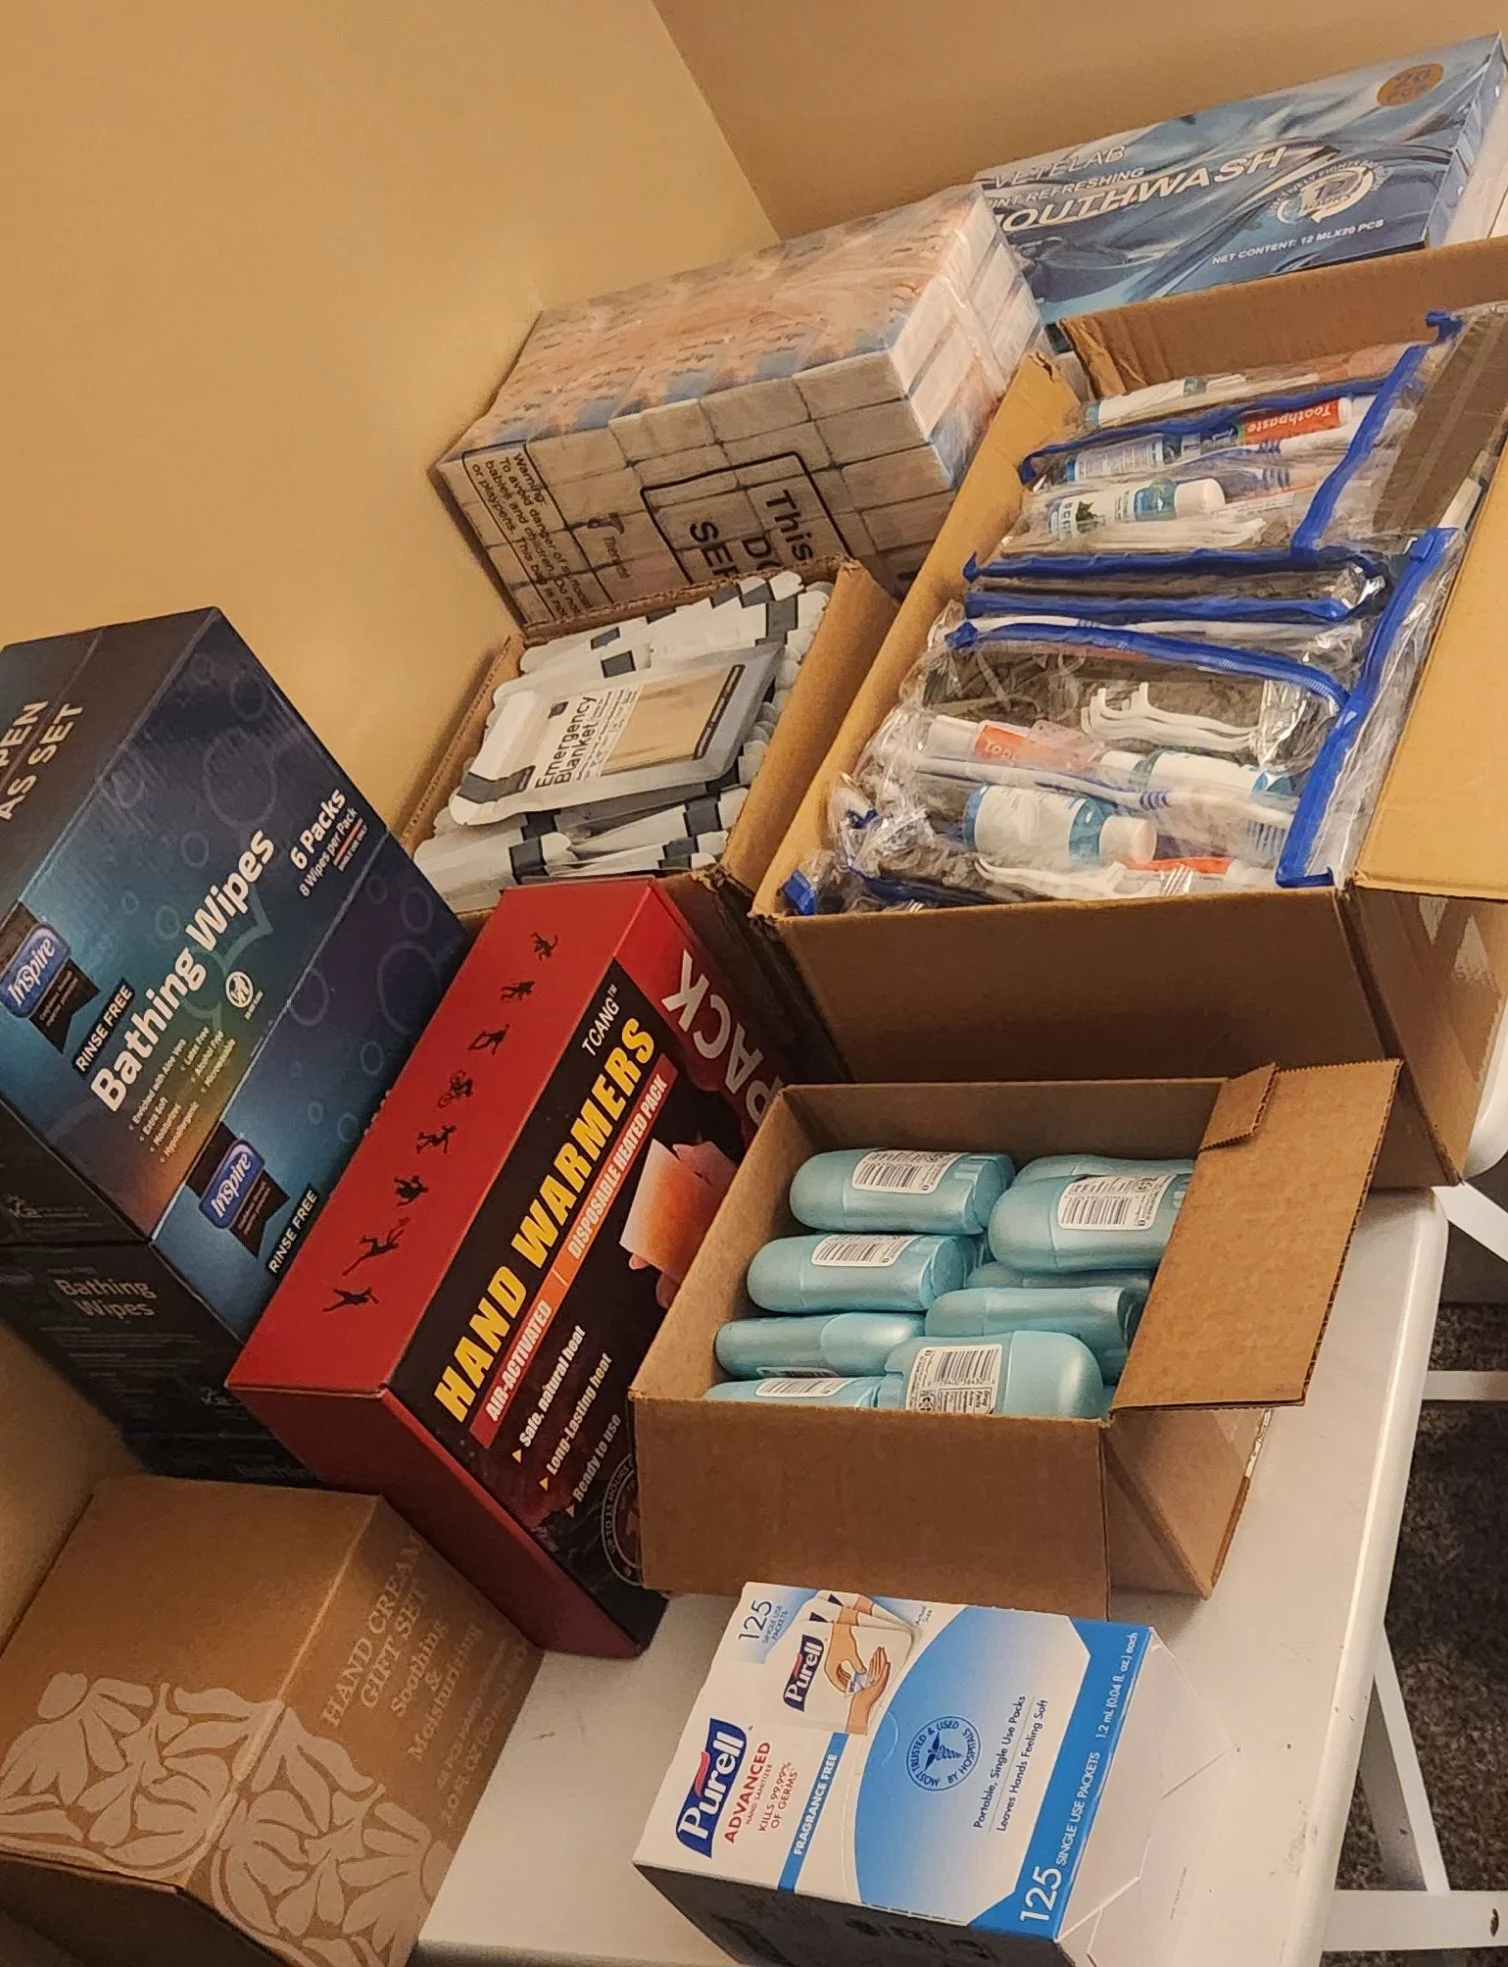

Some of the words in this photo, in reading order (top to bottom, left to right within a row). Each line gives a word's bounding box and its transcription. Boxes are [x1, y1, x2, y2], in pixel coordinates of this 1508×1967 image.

[1212, 252, 1236, 265] NET
[1247, 405, 1332, 435] Toothpaste
[500, 458, 510, 471] To
[510, 502, 526, 523] and
[765, 489, 814, 562] This
[29, 702, 83, 767] SET
[535, 696, 597, 789] Emergency
[553, 717, 598, 785] Blanket
[290, 846, 308, 870] 6
[300, 789, 346, 854] Packs
[327, 832, 341, 856] per
[336, 808, 358, 835] Pack
[299, 883, 310, 897] 8
[304, 851, 330, 887] Wipes
[90, 947, 208, 1112] Bathing
[185, 829, 276, 952] Wipes
[74, 1022, 109, 1072] RINSE
[102, 984, 133, 1034] FREE
[210, 1153, 252, 1219] Inspire
[433, 1266, 527, 1423] HAND
[511, 1017, 655, 1269] WARMERS
[268, 1229, 297, 1274] RINSE
[292, 1190, 318, 1229] FREE
[485, 1299, 552, 1422] AIR-ACTIVATED
[567, 1161, 620, 1260] DISPOSABLE
[614, 1112, 649, 1174] HEATED
[640, 1073, 668, 1121] PACK
[55, 1278, 158, 1300] Bathing
[75, 1299, 155, 1320] Wipes
[519, 1411, 544, 1448] Safe,
[540, 1358, 569, 1414] natural
[563, 1325, 586, 1361] heat
[546, 1383, 597, 1476] Long-Lasting
[590, 1352, 613, 1389] heat
[573, 1461, 601, 1502] Ready
[596, 1439, 608, 1461] to
[604, 1413, 622, 1443] use
[360, 1635, 401, 1709] GIFT
[395, 1581, 427, 1640] SET
[739, 1600, 773, 1641] 125
[321, 1636, 373, 1728] HAND
[391, 1619, 448, 1717] Soothing
[407, 1623, 483, 1762] Moisturizing
[425, 1667, 442, 1692] &
[784, 1640, 824, 1701] Purell
[912, 1732, 929, 1771] TRUSTED
[935, 1719, 959, 1733] USED
[947, 1767, 959, 1784] BY
[958, 1728, 980, 1779] HOSPITALS
[678, 1731, 745, 1840] Purell
[724, 1742, 771, 1844] ADVANCED
[746, 1803, 758, 1825] HAND
[753, 1764, 773, 1801] SANITIZER
[758, 1798, 775, 1832] KILLS
[770, 1761, 792, 1801] 99.99%
[914, 1763, 940, 1786] MOST
[973, 1783, 999, 1829] Portable,
[990, 1745, 1008, 1778] Single
[1002, 1732, 1016, 1753] Use
[1010, 1695, 1026, 1732] Packs
[996, 1790, 1017, 1832] Leaves
[1011, 1763, 1028, 1794] Hands
[1024, 1721, 1043, 1761] Feeling
[1034, 1699, 1049, 1719] Soft
[1019, 1864, 1062, 1922] 125
[1056, 1824, 1075, 1865] SINGLE
[1070, 1799, 1083, 1824] USE
[1079, 1752, 1101, 1800] PACKETS
[1103, 1704, 1114, 1723] mL
[1127, 1632, 1139, 1652] each
[771, 1810, 781, 1829] OF
[793, 1785, 825, 1855] FRAGRANCE
[820, 1753, 838, 1784] FREE
